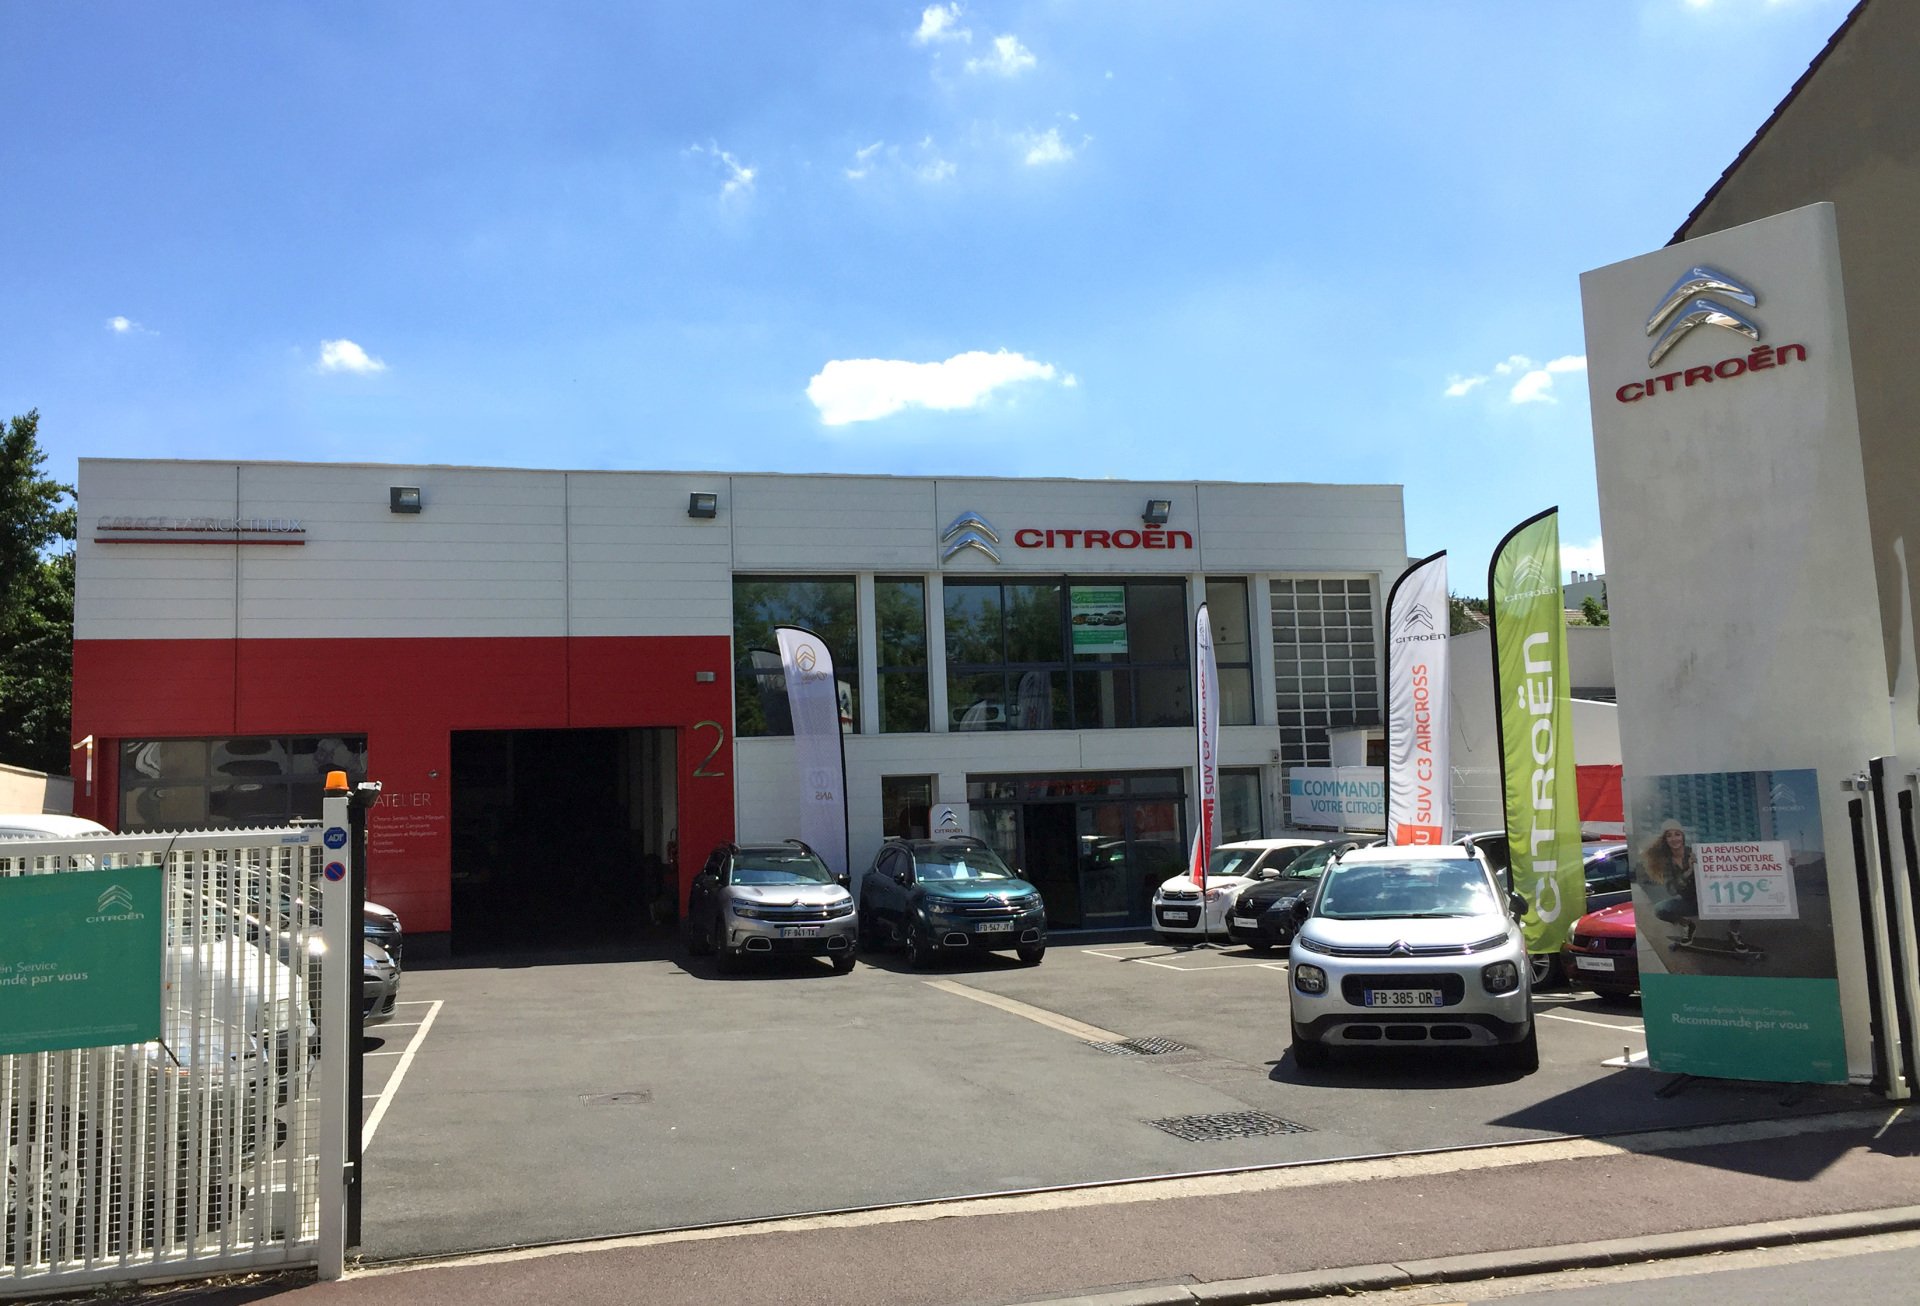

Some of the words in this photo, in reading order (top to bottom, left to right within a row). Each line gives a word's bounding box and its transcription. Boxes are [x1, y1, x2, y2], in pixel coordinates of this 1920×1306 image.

[1412, 664, 1432, 753] AIRCROSS
[692, 720, 725, 777] 2
[72, 734, 93, 797] 1
[1418, 757, 1432, 781] C3
[373, 792, 432, 808] ATELIER
[1311, 799, 1343, 813] VOTRE
[1417, 785, 1432, 823] SUV
[327, 833, 344, 842] ADT
[1701, 846, 1713, 854] LA
[1702, 855, 1714, 863] DE
[1716, 854, 1732, 863] MA
[1733, 854, 1774, 862] VOITURE
[1703, 864, 1715, 872] DE
[1716, 863, 1738, 872] PLUS
[1740, 863, 1752, 872] DE
[1754, 863, 1760, 871] 3
[1761, 863, 1782, 871] ANS
[17, 961, 58, 973] Service
[0, 974, 28, 986] ndé
[31, 975, 55, 987] par
[58, 972, 88, 981] vous
[1755, 1020, 1776, 1031] par
[1779, 1022, 1809, 1030] vous
